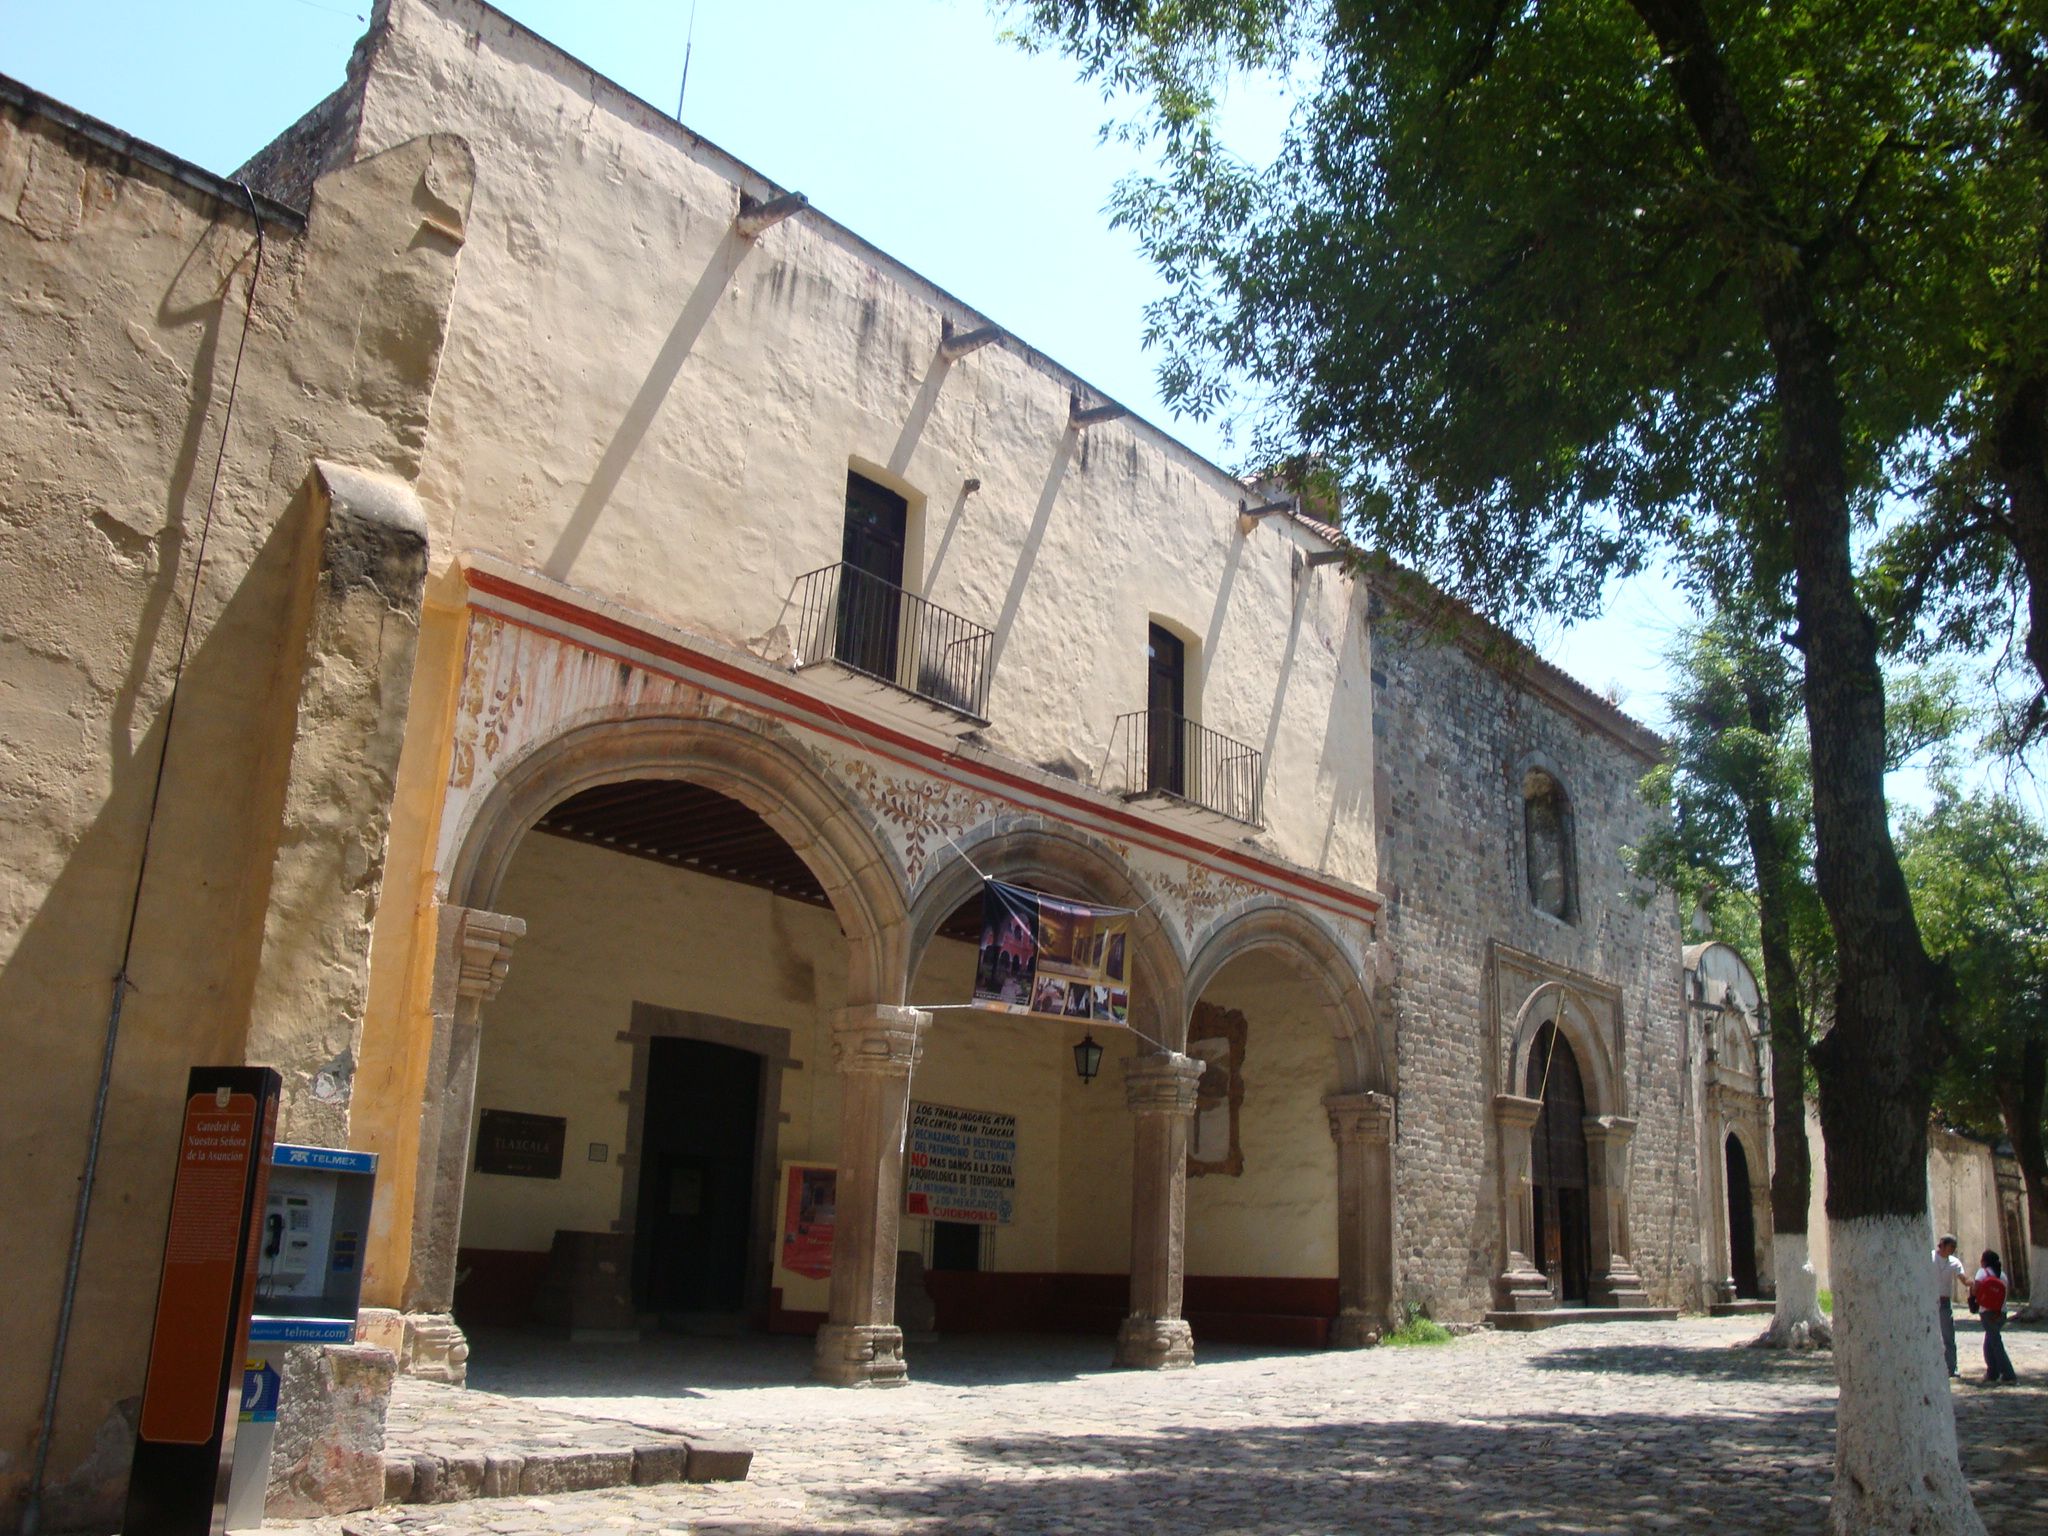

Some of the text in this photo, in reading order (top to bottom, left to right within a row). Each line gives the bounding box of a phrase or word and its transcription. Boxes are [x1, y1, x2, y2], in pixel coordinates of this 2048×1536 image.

[917, 1104, 1015, 1126] LOS TRABAJADORES ATM
[197, 1120, 240, 1132] Catedral de
[914, 1116, 1014, 1137] DEL CENTRO INAH TLAXCALA
[188, 1135, 246, 1147] Nuestra Señora
[494, 1137, 550, 1153] TLAXCALA
[915, 1142, 926, 1152] DEL
[963, 1137, 970, 1145] LA
[187, 1149, 196, 1160] de
[199, 1150, 206, 1160] la
[312, 1154, 357, 1166] TELMEX
[911, 1152, 928, 1167] NO
[929, 1157, 945, 1168] MAS
[974, 1162, 978, 1172] A
[980, 1162, 988, 1173] LA
[991, 1164, 1012, 1175] ZONA
[960, 1174, 967, 1184] DE
[285, 1326, 346, 1339] telmex.com
